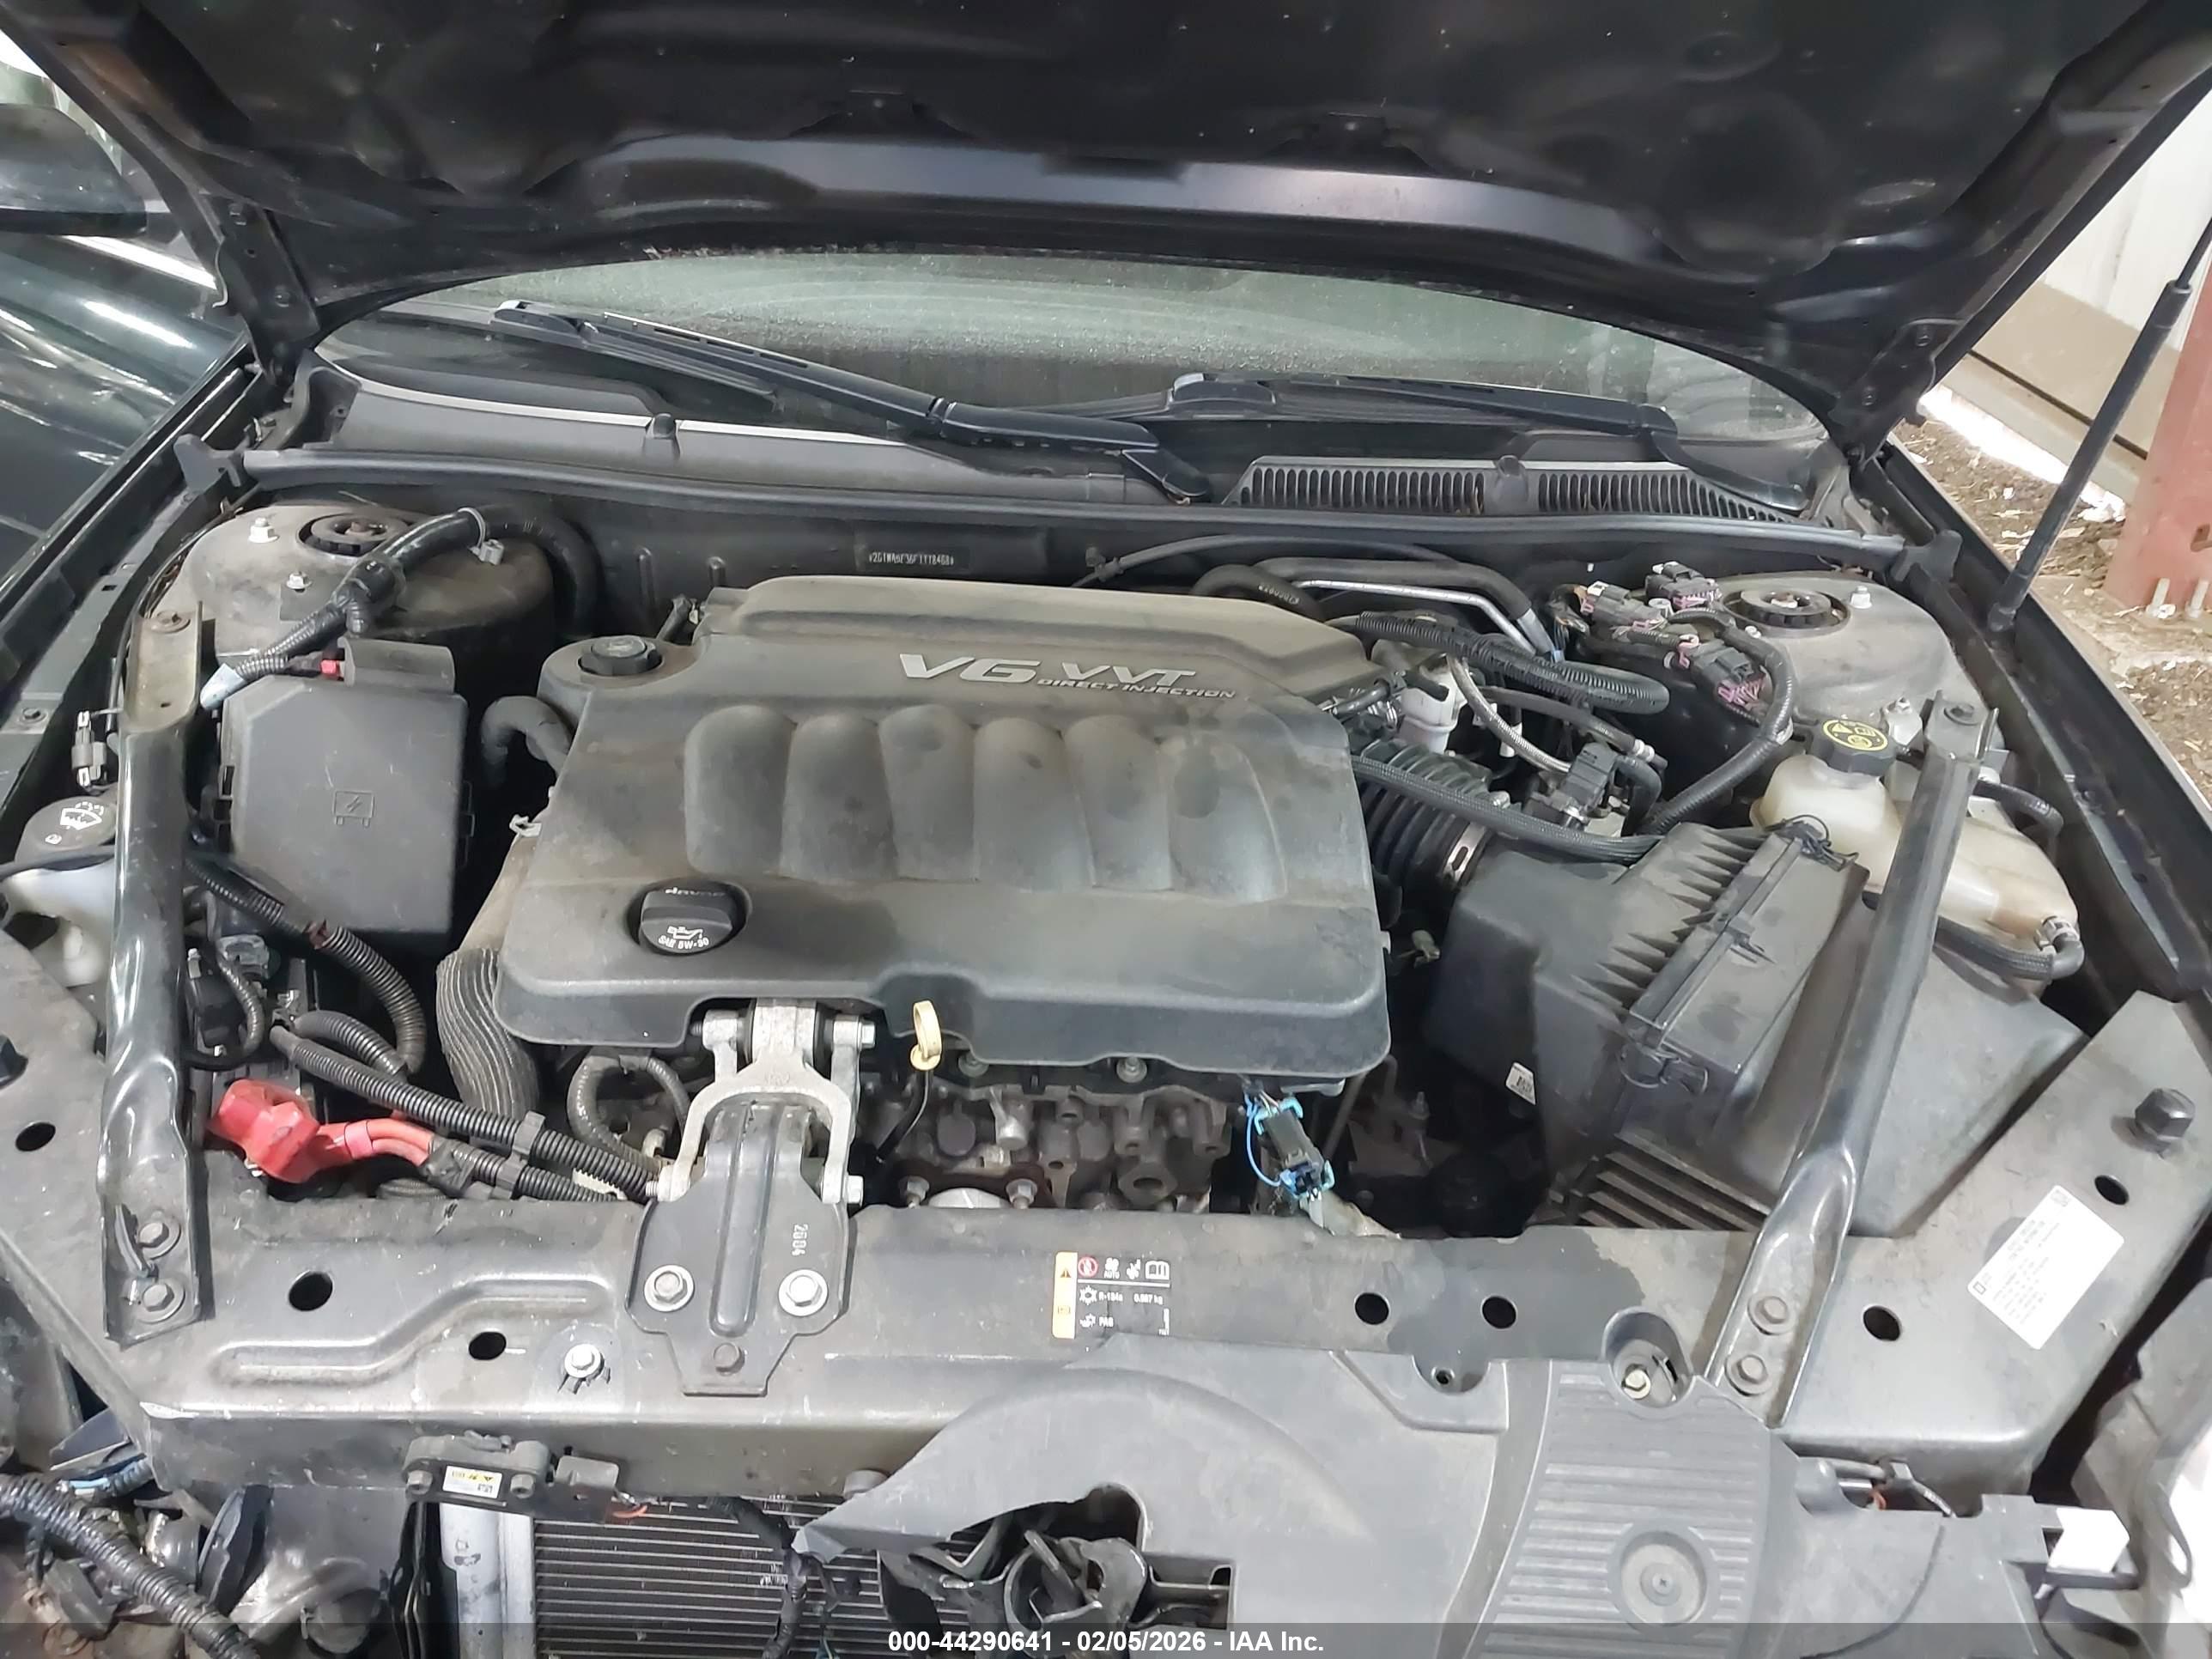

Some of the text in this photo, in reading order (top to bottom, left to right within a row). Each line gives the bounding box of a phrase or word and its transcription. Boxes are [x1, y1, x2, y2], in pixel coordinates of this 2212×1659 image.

[900, 653, 1196, 687] V6 VVT
[1036, 678, 1236, 698] DIRECT INJECTION
[678, 937, 709, 950] 5W-30
[1103, 1270, 1120, 1279] AUTO
